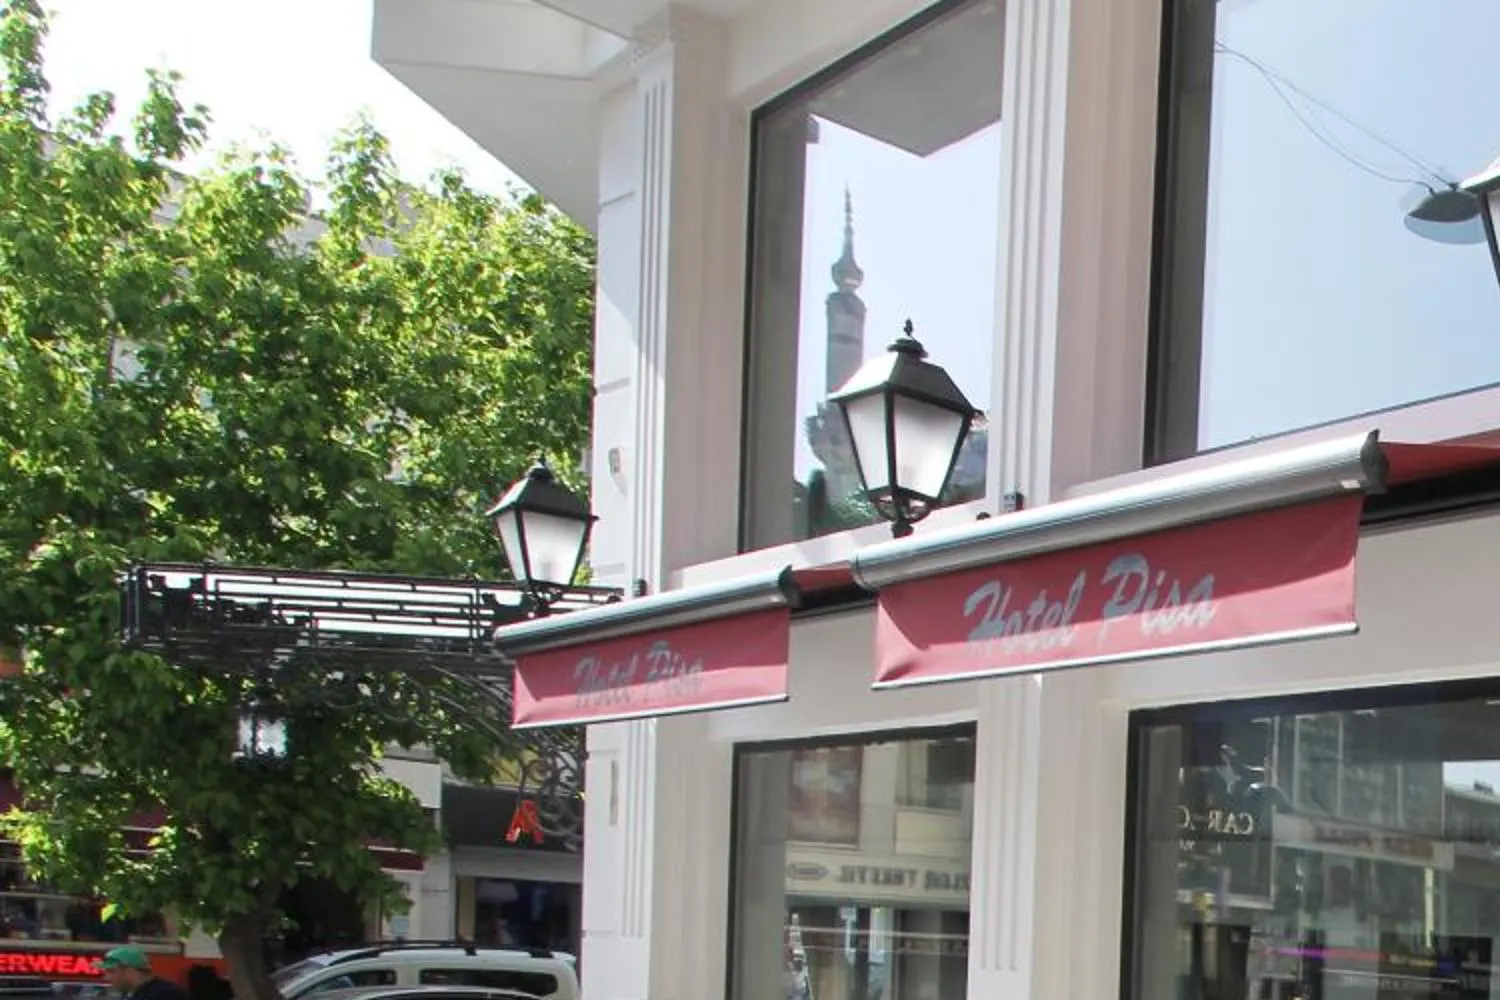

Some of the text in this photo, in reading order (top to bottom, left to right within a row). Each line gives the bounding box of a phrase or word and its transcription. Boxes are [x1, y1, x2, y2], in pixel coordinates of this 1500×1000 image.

[963, 553, 1216, 656] Hotel Pisa
[573, 640, 705, 708] Hotel Pisa
